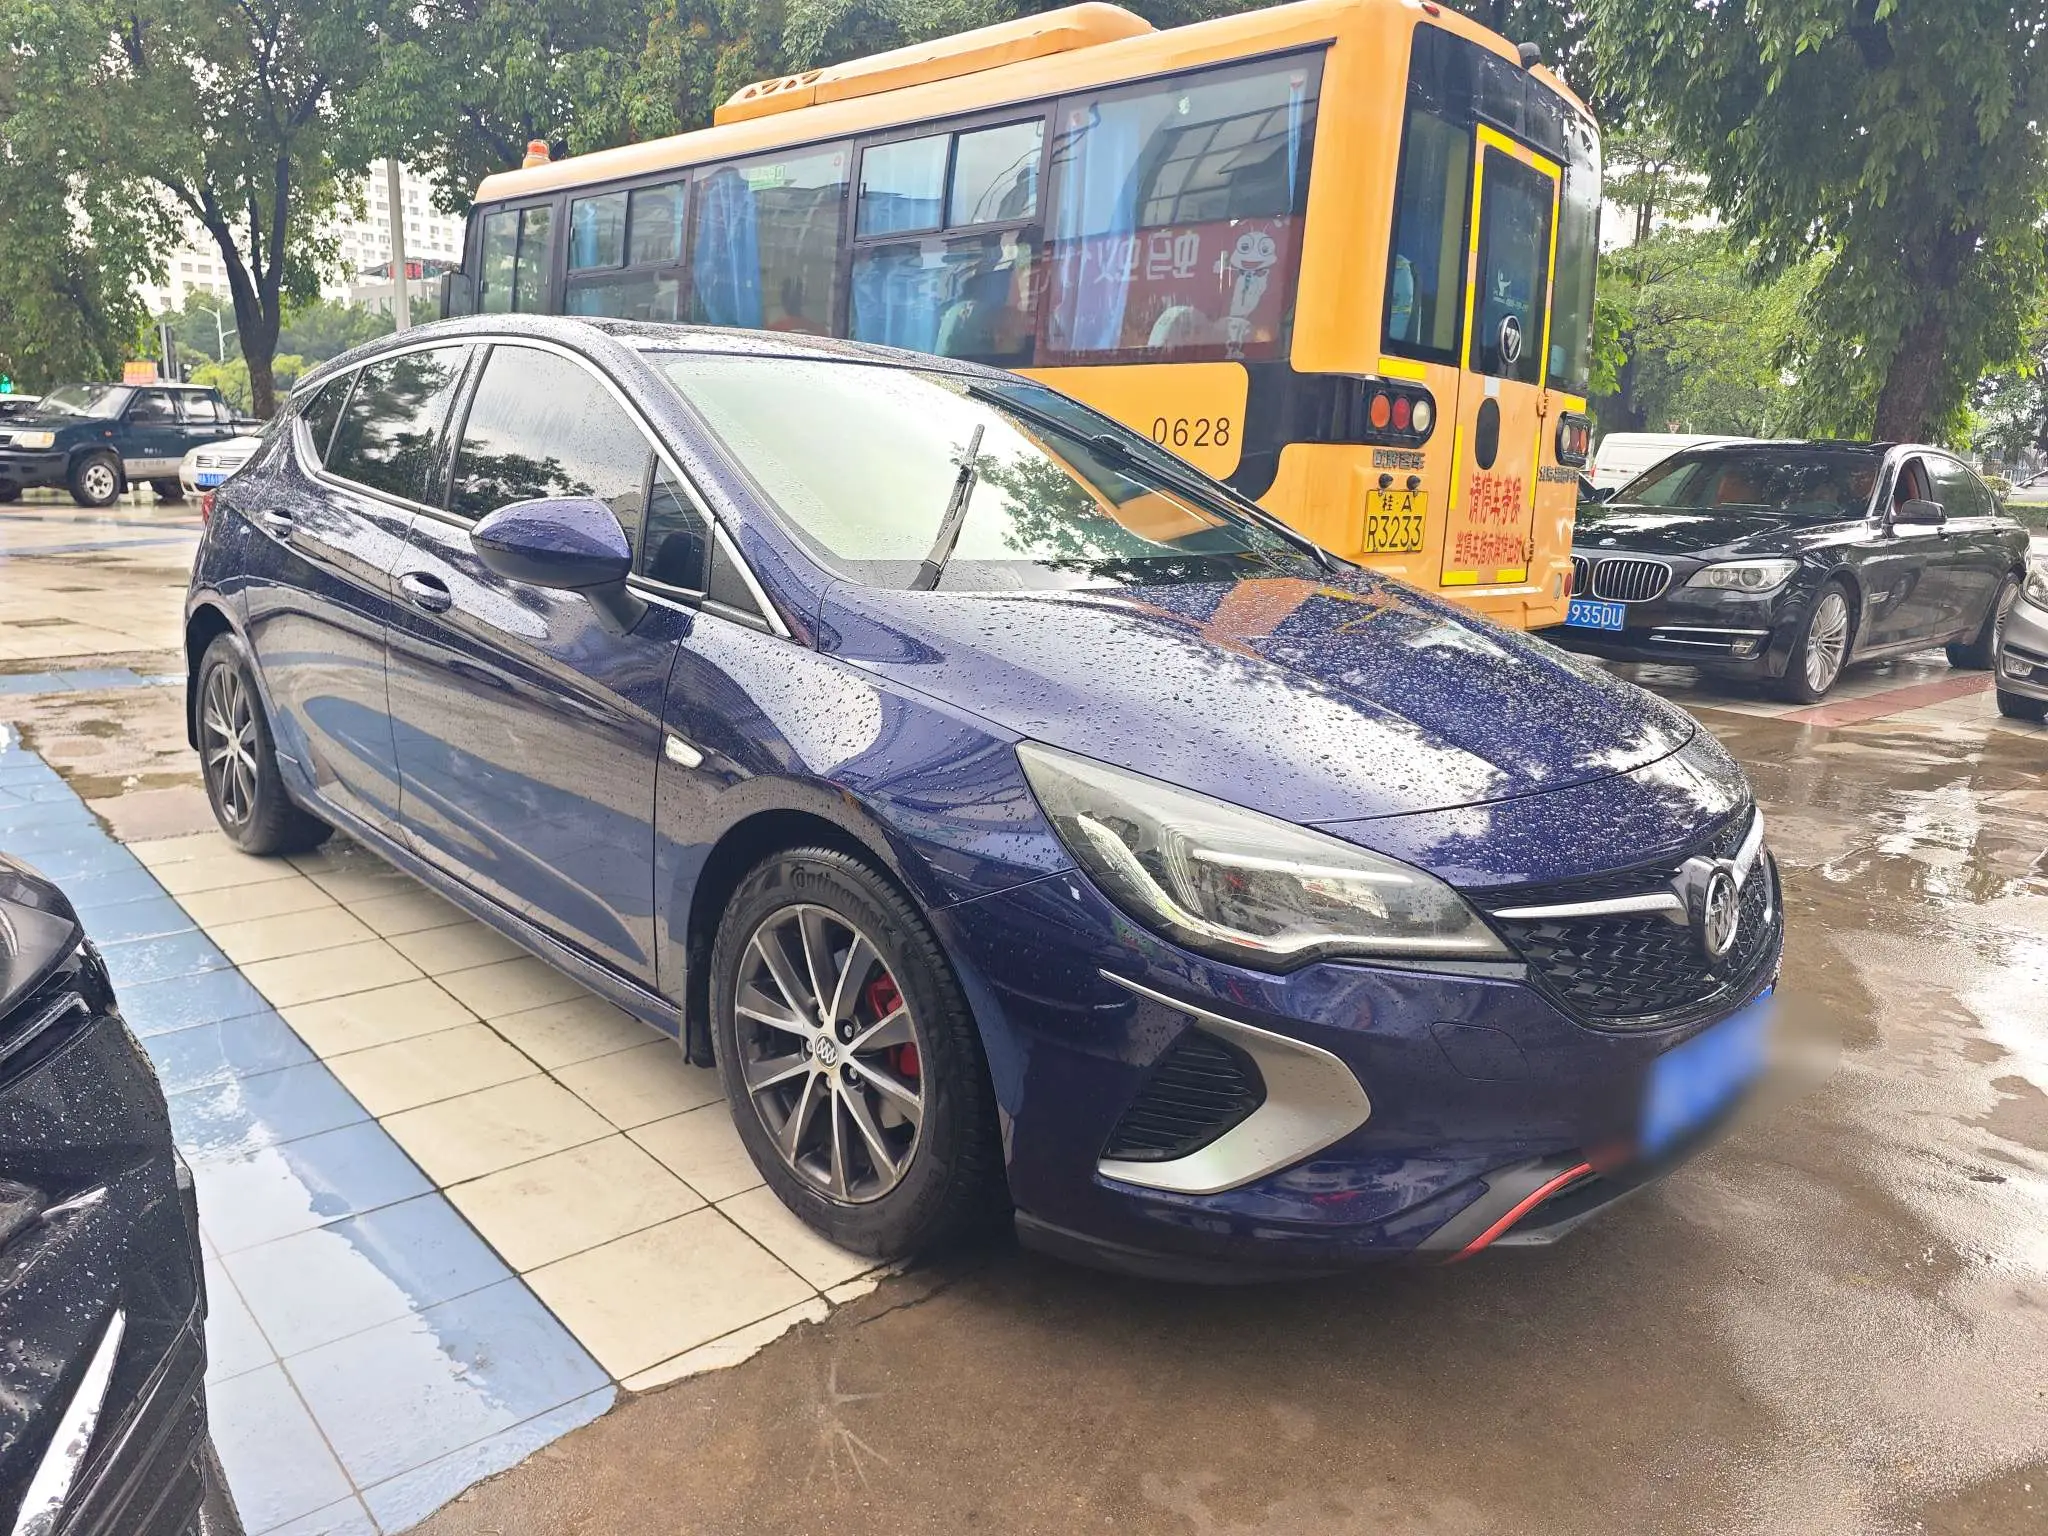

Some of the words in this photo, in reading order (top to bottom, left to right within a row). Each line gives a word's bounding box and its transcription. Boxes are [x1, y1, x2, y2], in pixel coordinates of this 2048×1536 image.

[1152, 417, 1230, 447] 0628
[1469, 472, 1521, 525] 请停车等候
[1366, 515, 1423, 549] R3233
